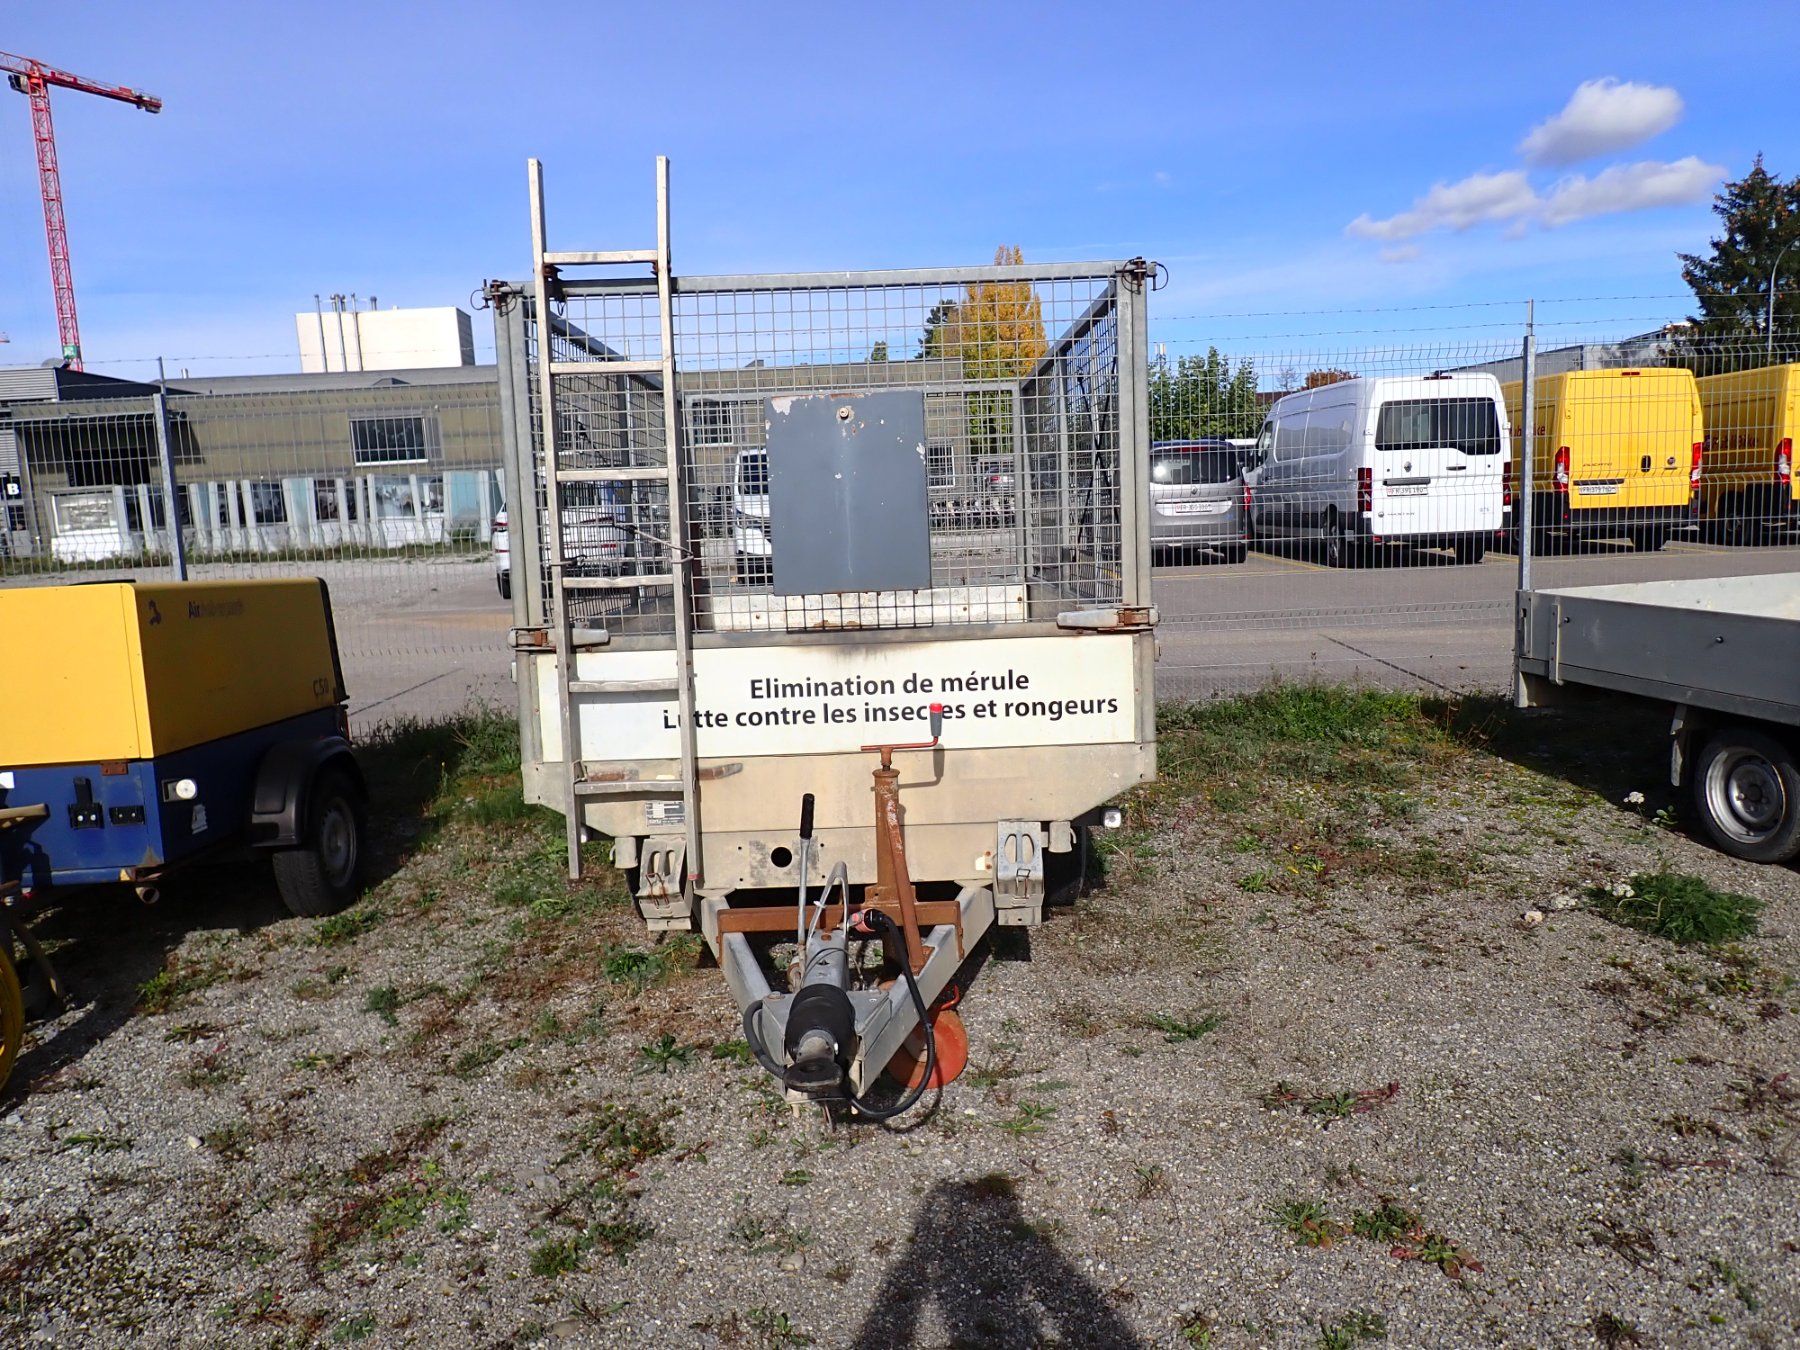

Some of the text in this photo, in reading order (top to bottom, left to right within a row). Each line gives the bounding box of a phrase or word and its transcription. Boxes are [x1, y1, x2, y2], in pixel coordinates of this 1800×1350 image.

[6, 484, 19, 495] B
[750, 669, 1030, 698] Elimination de mérule
[664, 697, 1118, 729] Ltte contre les inseces et rongeurs
